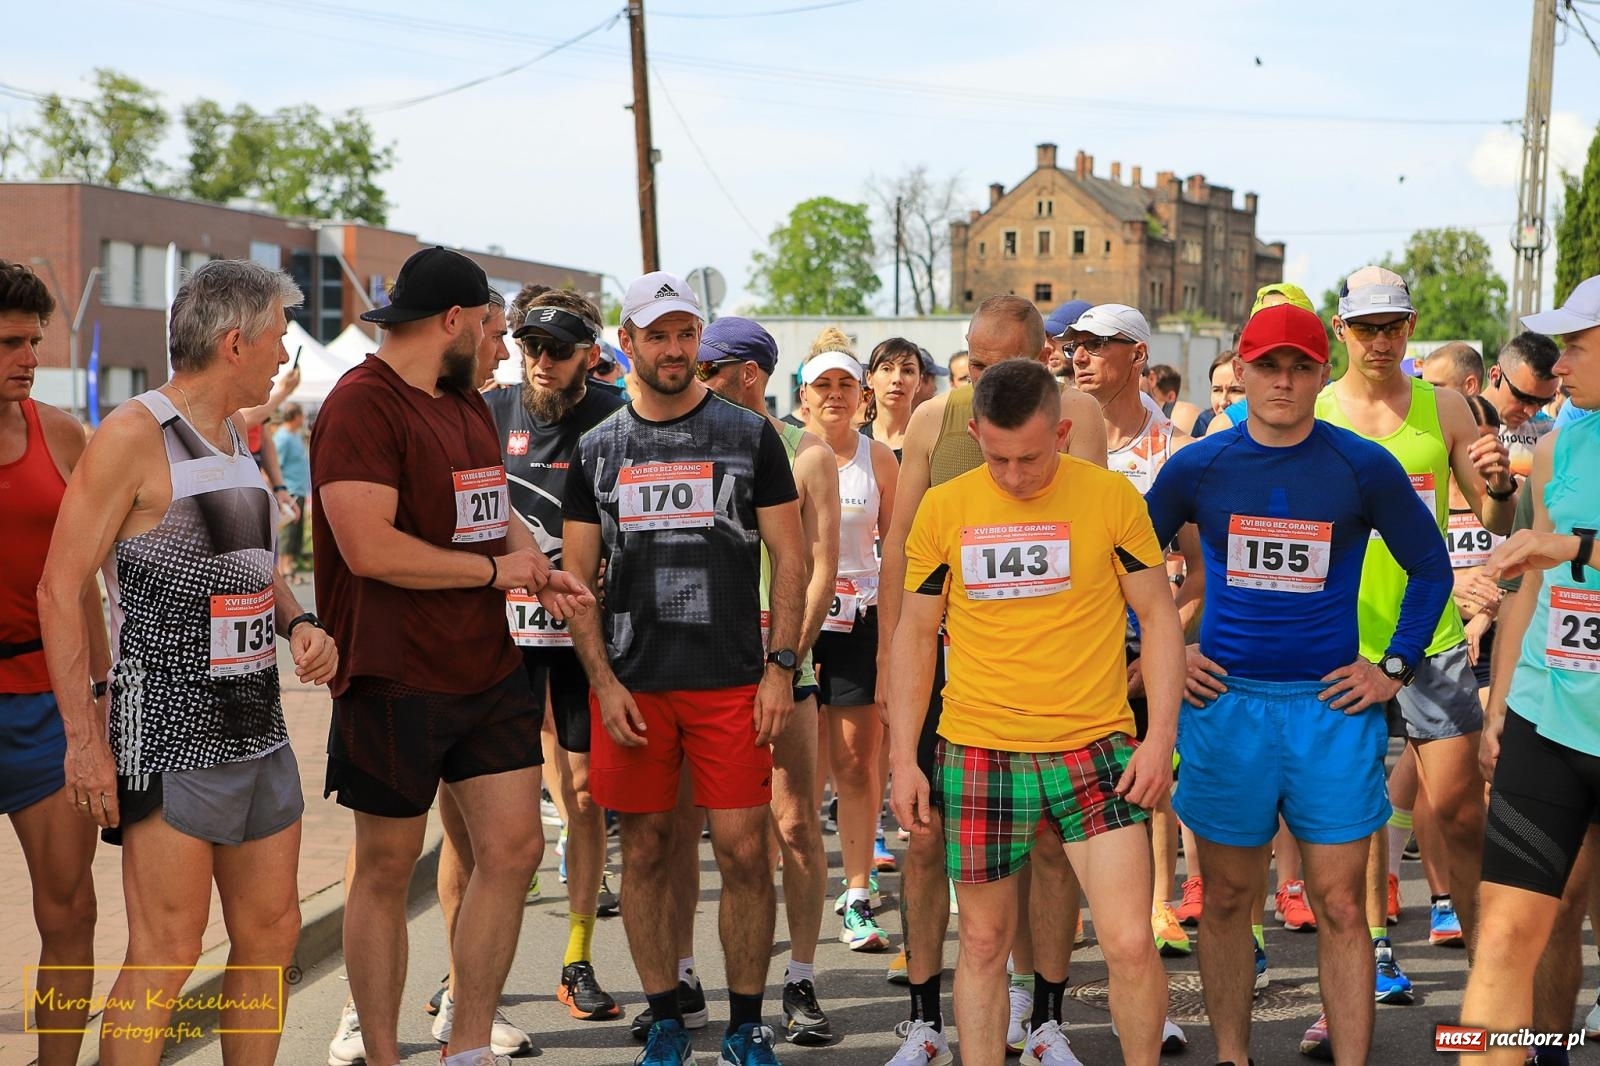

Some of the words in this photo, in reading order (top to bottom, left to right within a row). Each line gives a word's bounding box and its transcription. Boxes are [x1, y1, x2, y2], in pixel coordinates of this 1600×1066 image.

[654, 291, 680, 299] adidas
[470, 491, 499, 522] 217
[638, 483, 693, 512] 170
[988, 526, 1007, 534] BIEG
[1024, 524, 1057, 532] GRANIC
[1254, 520, 1272, 528] BIEG
[1273, 521, 1288, 529] BEZ
[1288, 523, 1320, 531] GRANIC
[1447, 530, 1492, 553] 149
[982, 545, 1049, 579] 143
[1246, 540, 1310, 573] 155
[224, 598, 240, 606] XVI
[241, 597, 258, 606] BIEG
[233, 613, 274, 653] 135
